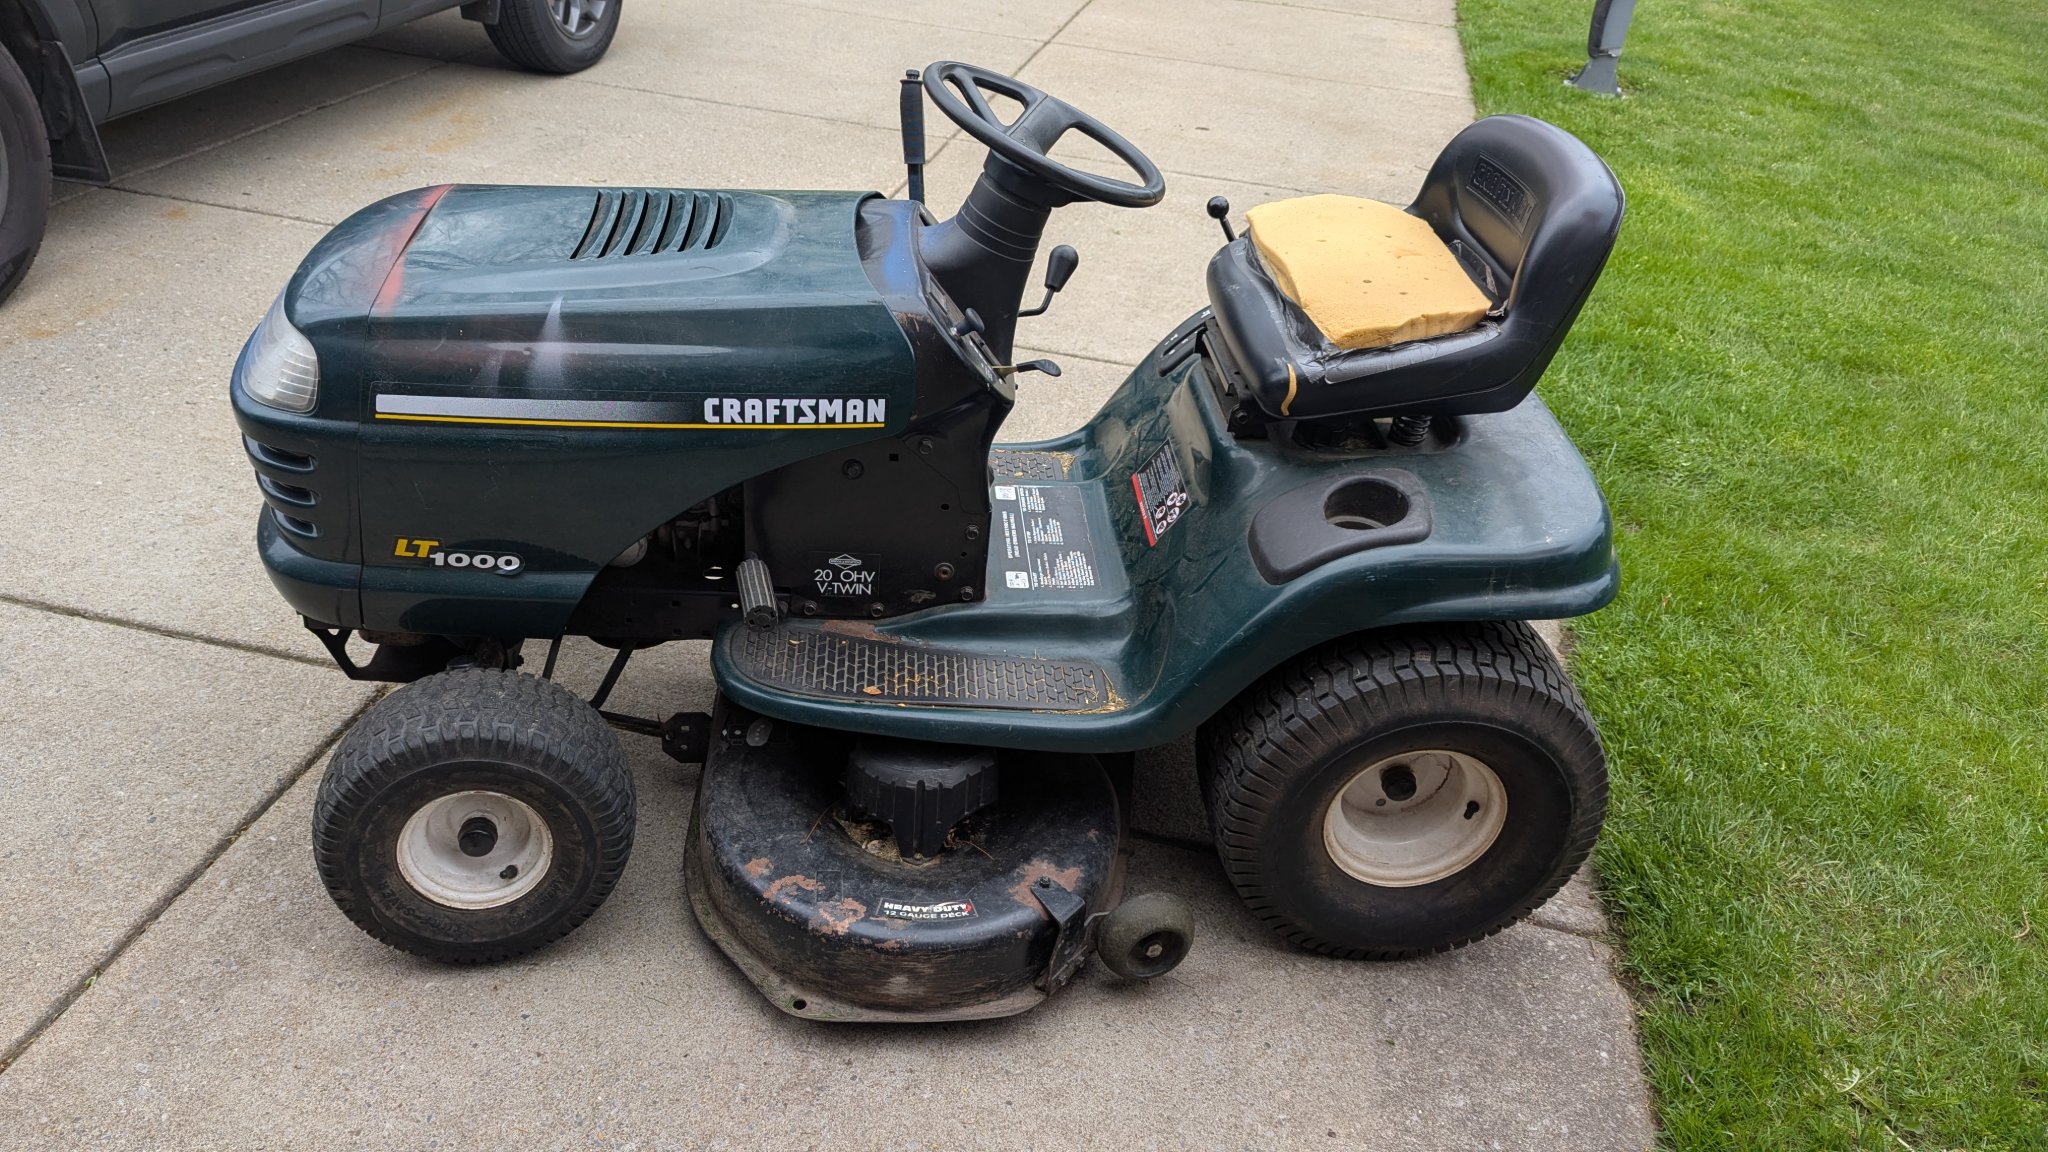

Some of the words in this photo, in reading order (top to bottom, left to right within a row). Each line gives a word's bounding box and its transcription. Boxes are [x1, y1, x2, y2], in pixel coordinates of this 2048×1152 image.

[704, 397, 886, 424] CRAFTSMAN
[394, 538, 439, 558] LT
[429, 552, 520, 571] 1000
[814, 569, 833, 582] 20
[840, 570, 876, 583] OHV
[816, 581, 872, 595] V-TWIN
[883, 902, 930, 912] HEAVY
[900, 911, 938, 919] GAUGE
[940, 911, 970, 919] DECK
